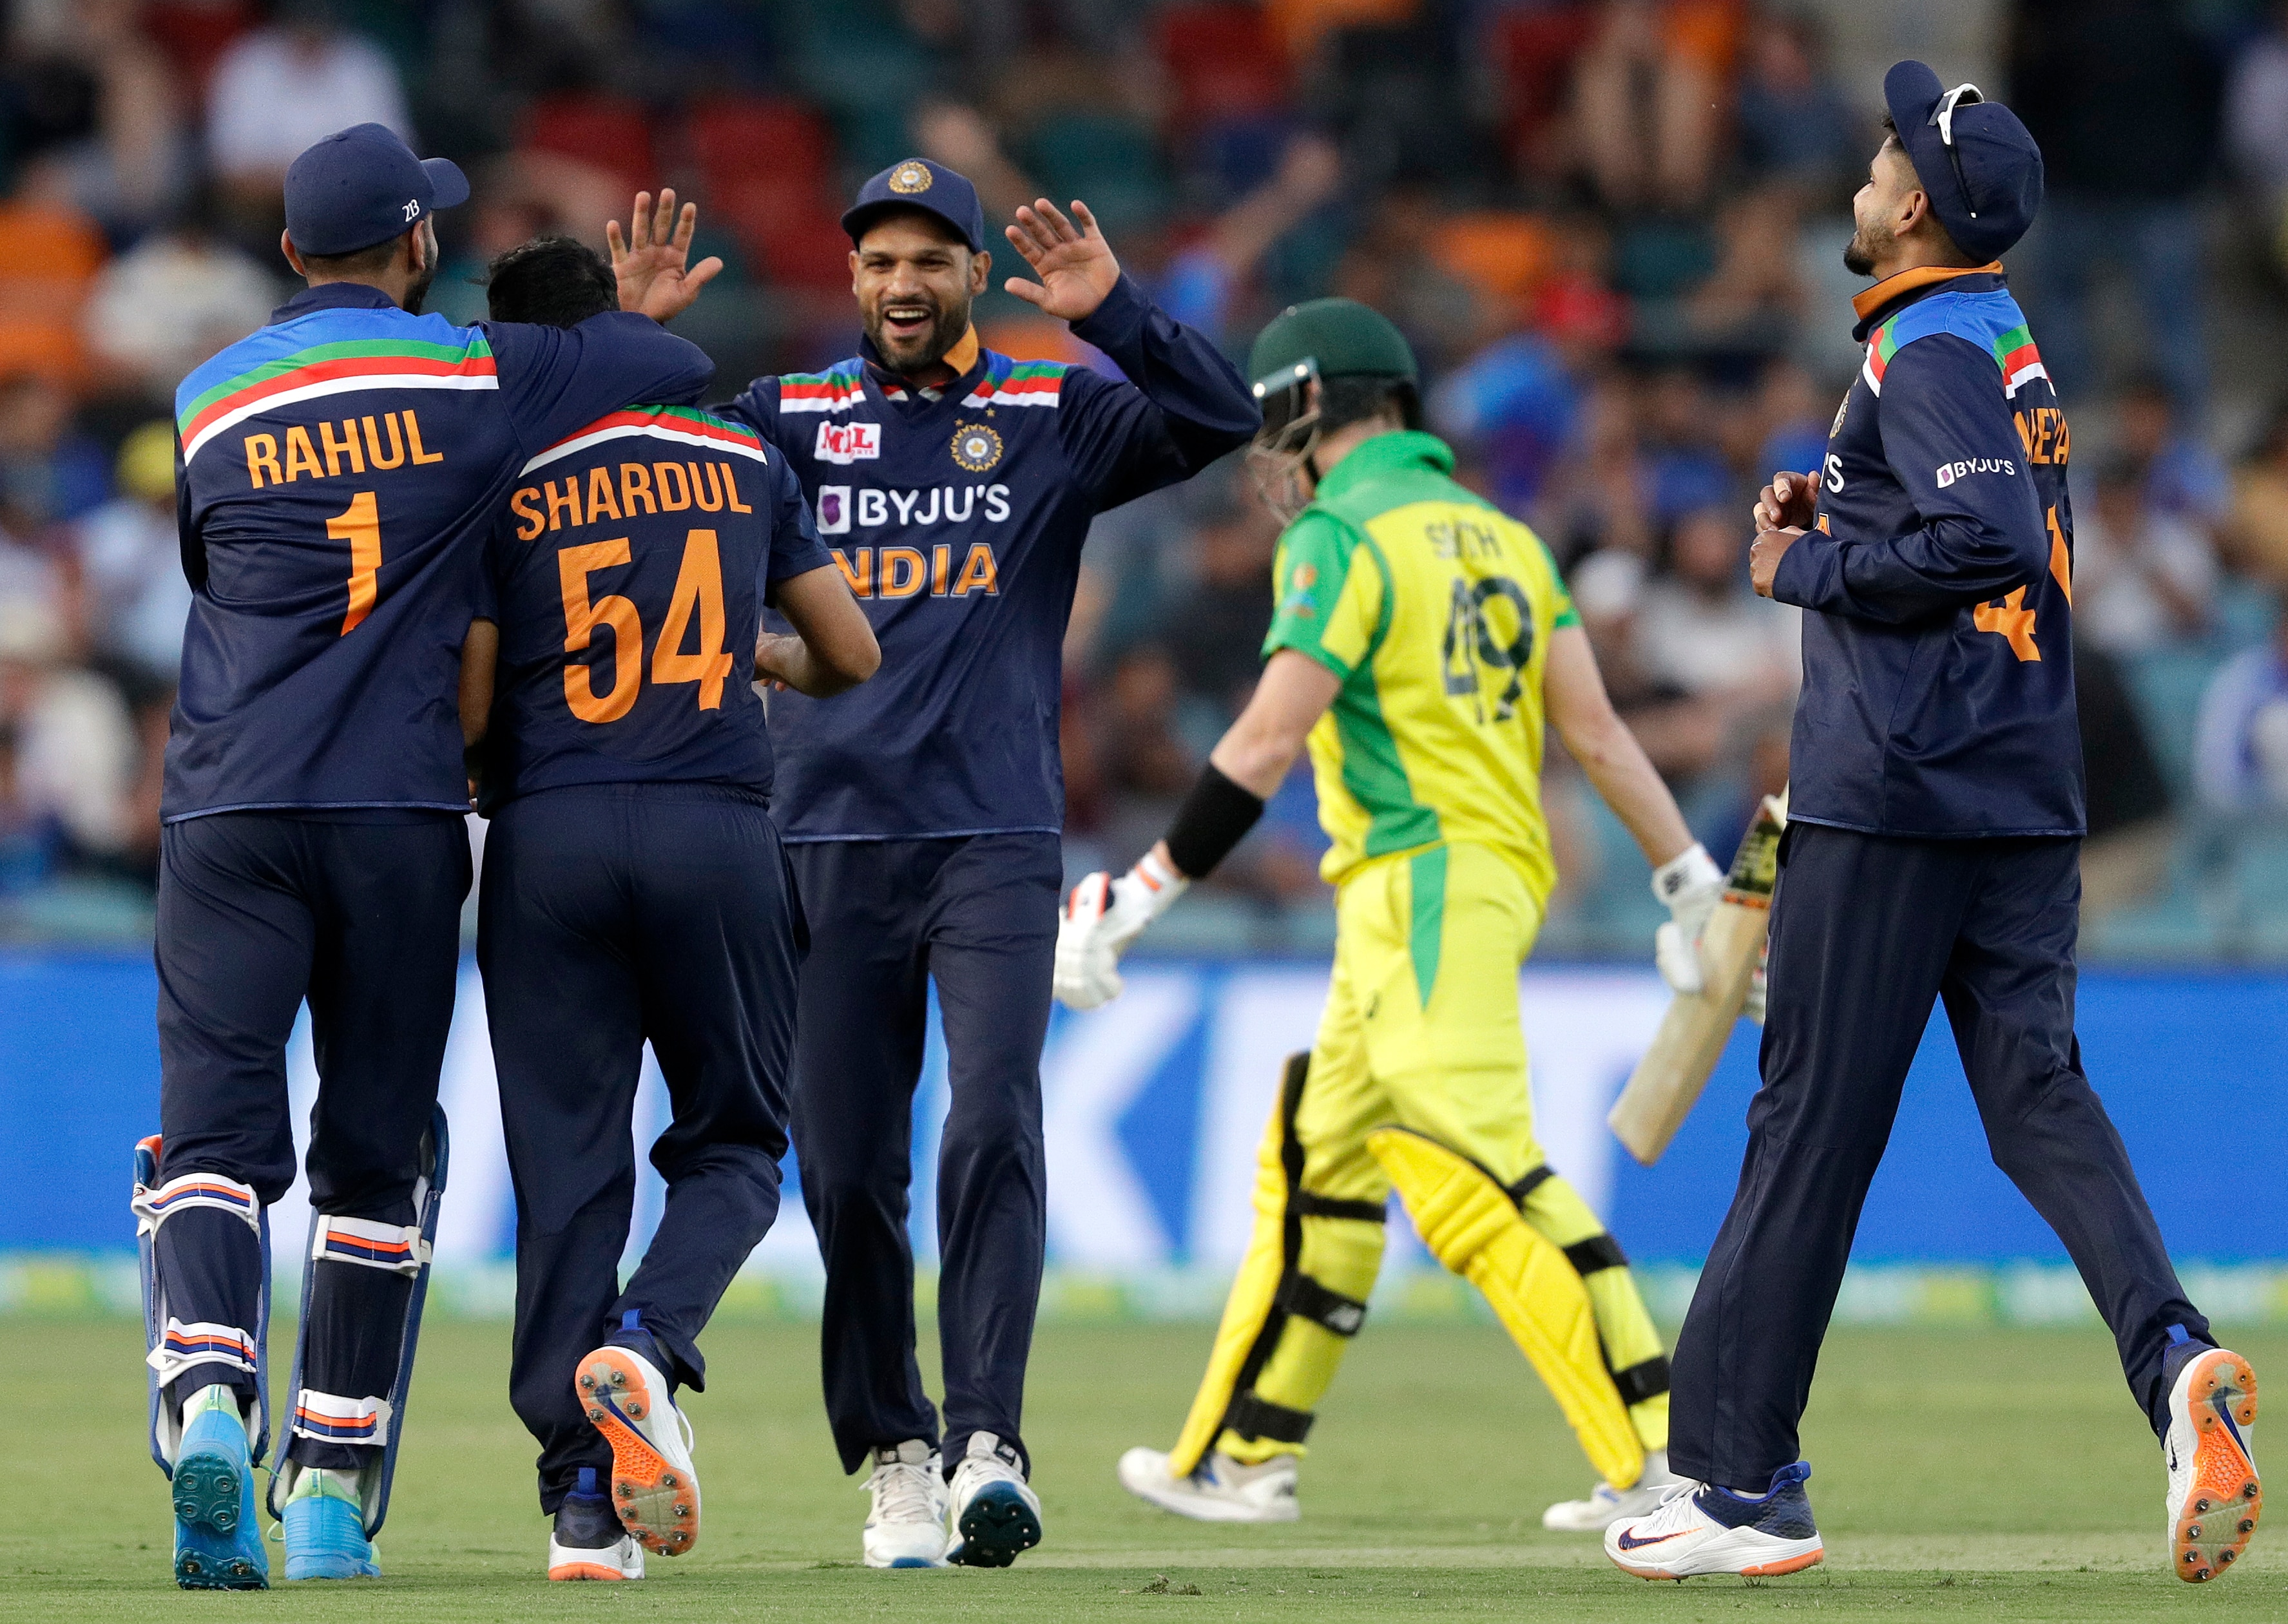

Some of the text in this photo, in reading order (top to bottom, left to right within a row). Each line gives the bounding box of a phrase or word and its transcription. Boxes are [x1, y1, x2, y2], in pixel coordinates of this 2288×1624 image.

[244, 409, 444, 489] RAHUL
[1954, 458, 2015, 479] BYJU'S
[510, 462, 753, 541] SHARDUL
[858, 484, 1011, 527] BYJU'S
[325, 491, 382, 637] 1
[829, 542, 999, 600] NDIA
[557, 529, 733, 724] 54
[1443, 577, 1533, 725] 49
